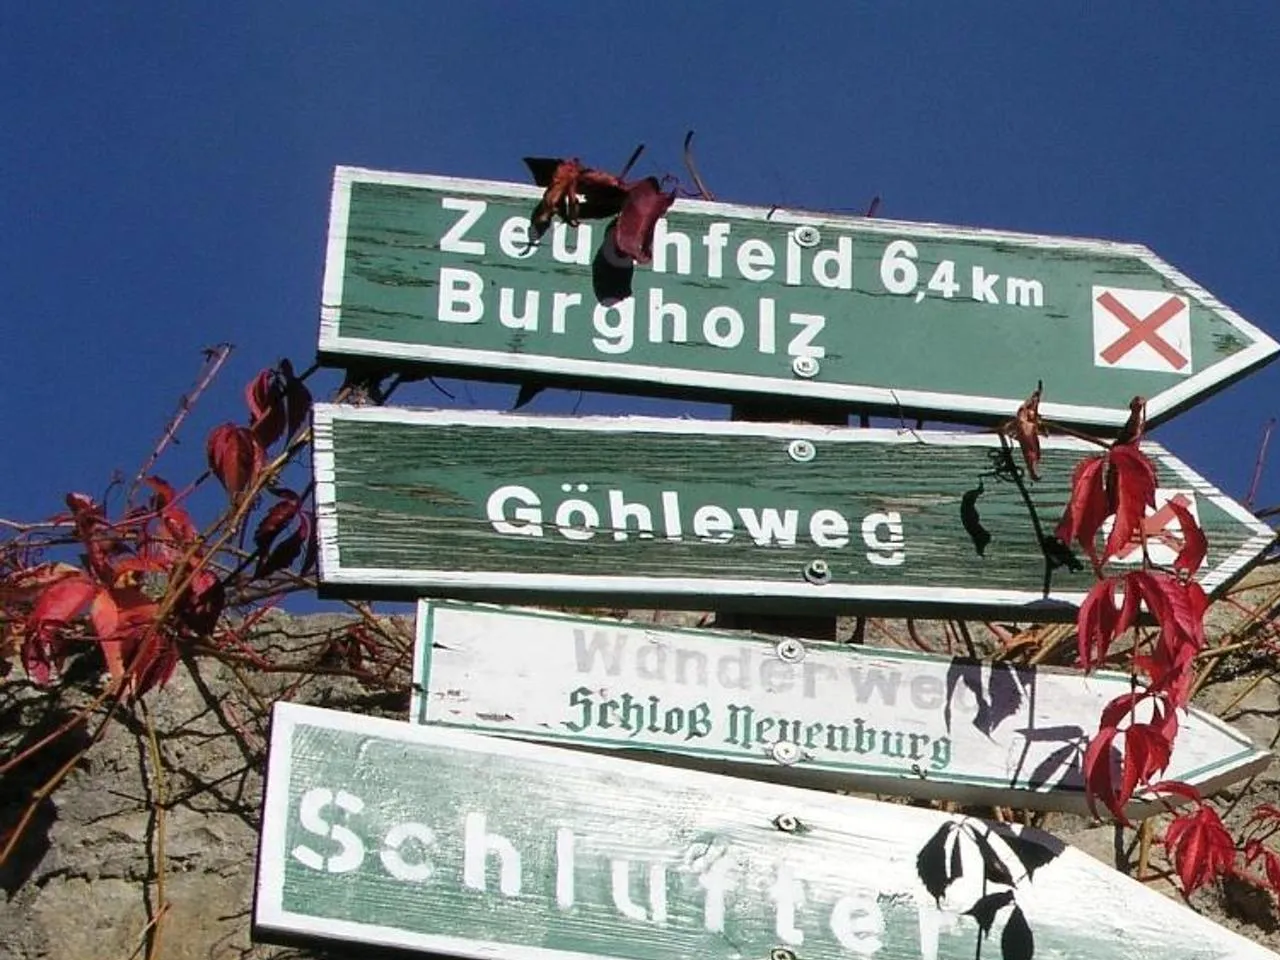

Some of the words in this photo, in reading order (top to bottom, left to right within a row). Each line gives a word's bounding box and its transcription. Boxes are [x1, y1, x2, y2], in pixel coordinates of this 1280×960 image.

[438, 266, 826, 360] Burgholz
[880, 239, 960, 304] 6,4
[971, 265, 1044, 307] km
[486, 483, 906, 567] Göhleweg
[560, 686, 713, 741] Schloß
[723, 703, 953, 770] Neuenburg
